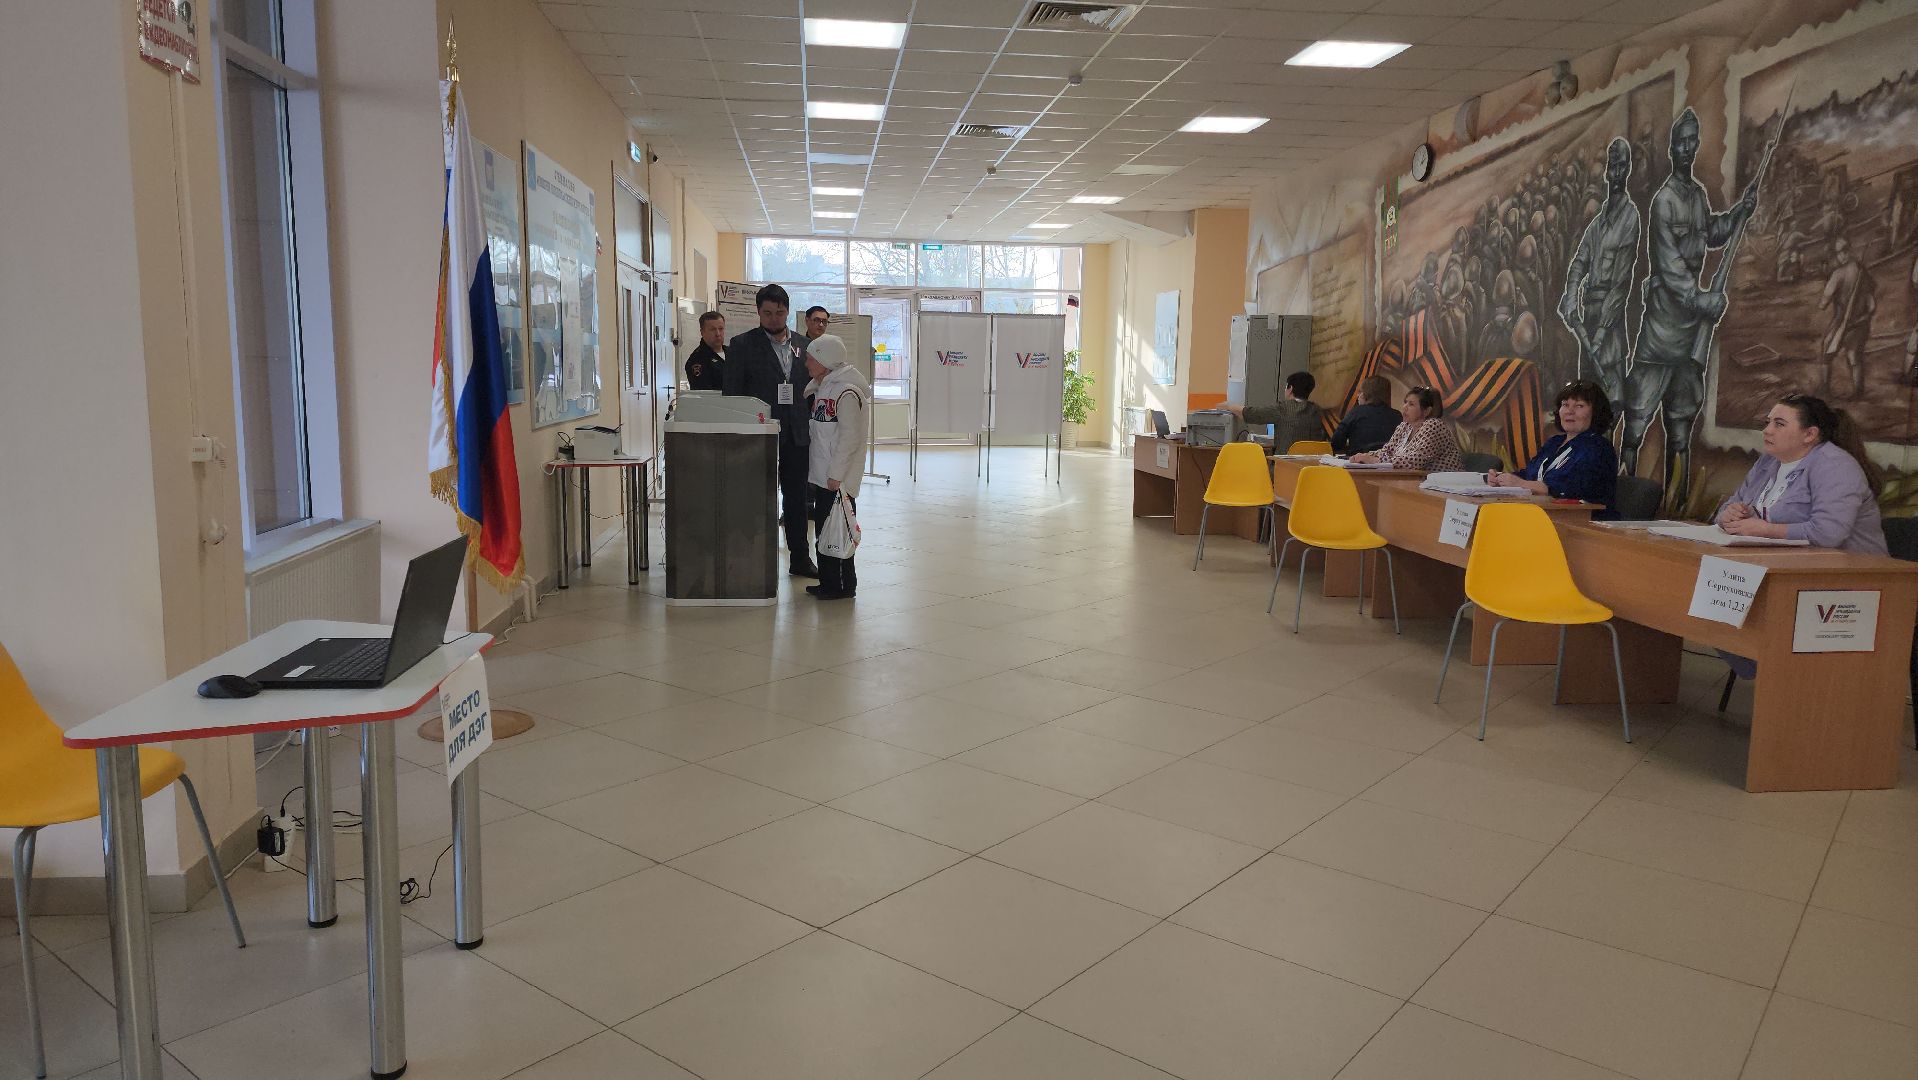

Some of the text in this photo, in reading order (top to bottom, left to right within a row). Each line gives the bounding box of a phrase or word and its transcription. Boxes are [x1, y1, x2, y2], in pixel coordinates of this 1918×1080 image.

[1722, 570, 1746, 583] Улица
[1710, 599, 1726, 608] дом
[448, 689, 481, 730] МЕСТО
[448, 711, 488, 768] ДЛЯ ДЭГ
